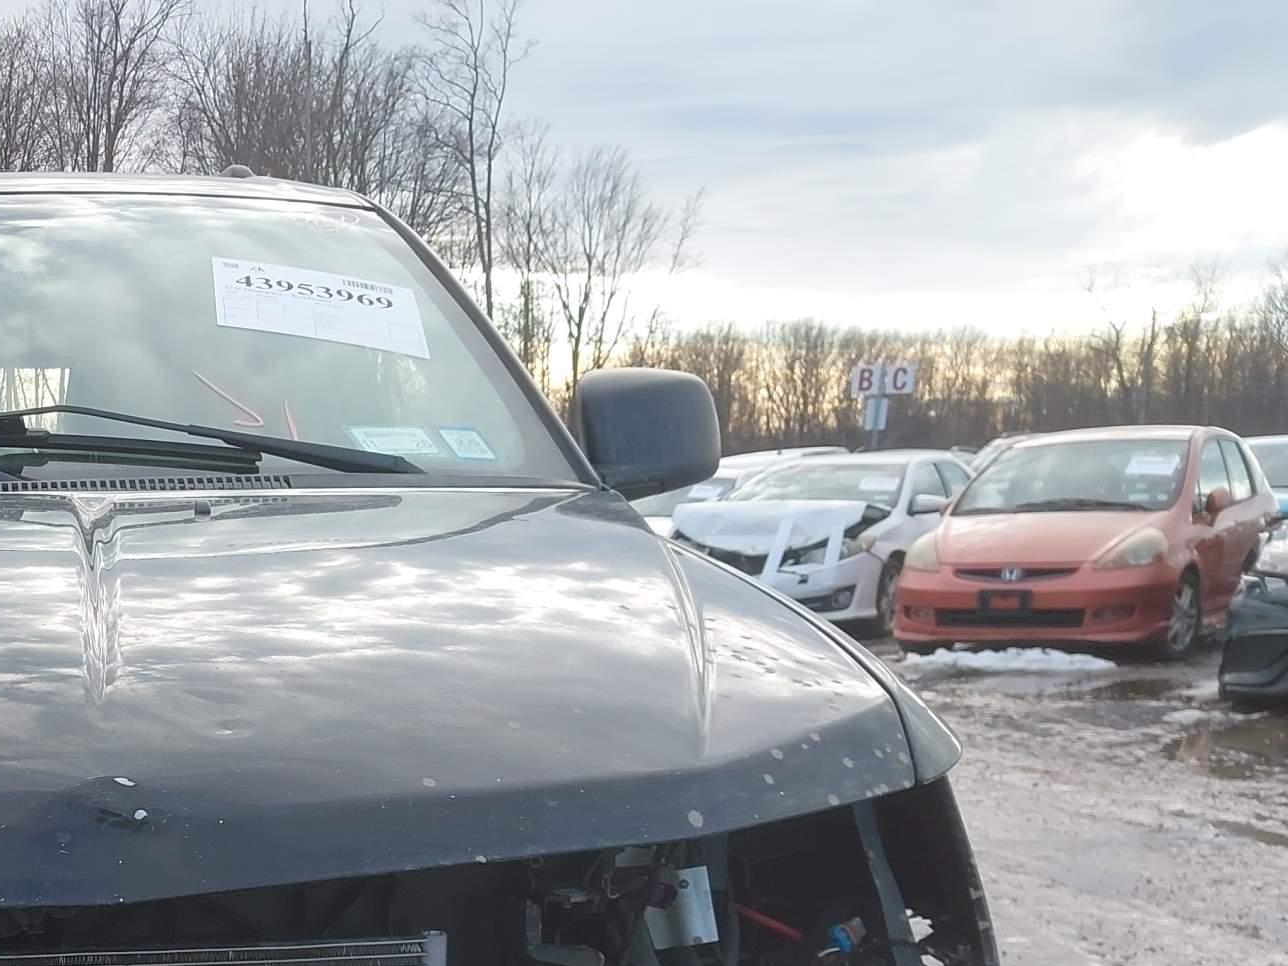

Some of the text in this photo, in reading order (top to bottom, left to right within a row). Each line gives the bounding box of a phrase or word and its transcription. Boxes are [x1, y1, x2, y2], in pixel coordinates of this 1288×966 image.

[235, 275, 394, 309] 43953969
[858, 368, 874, 391] B
[892, 367, 908, 390] C
